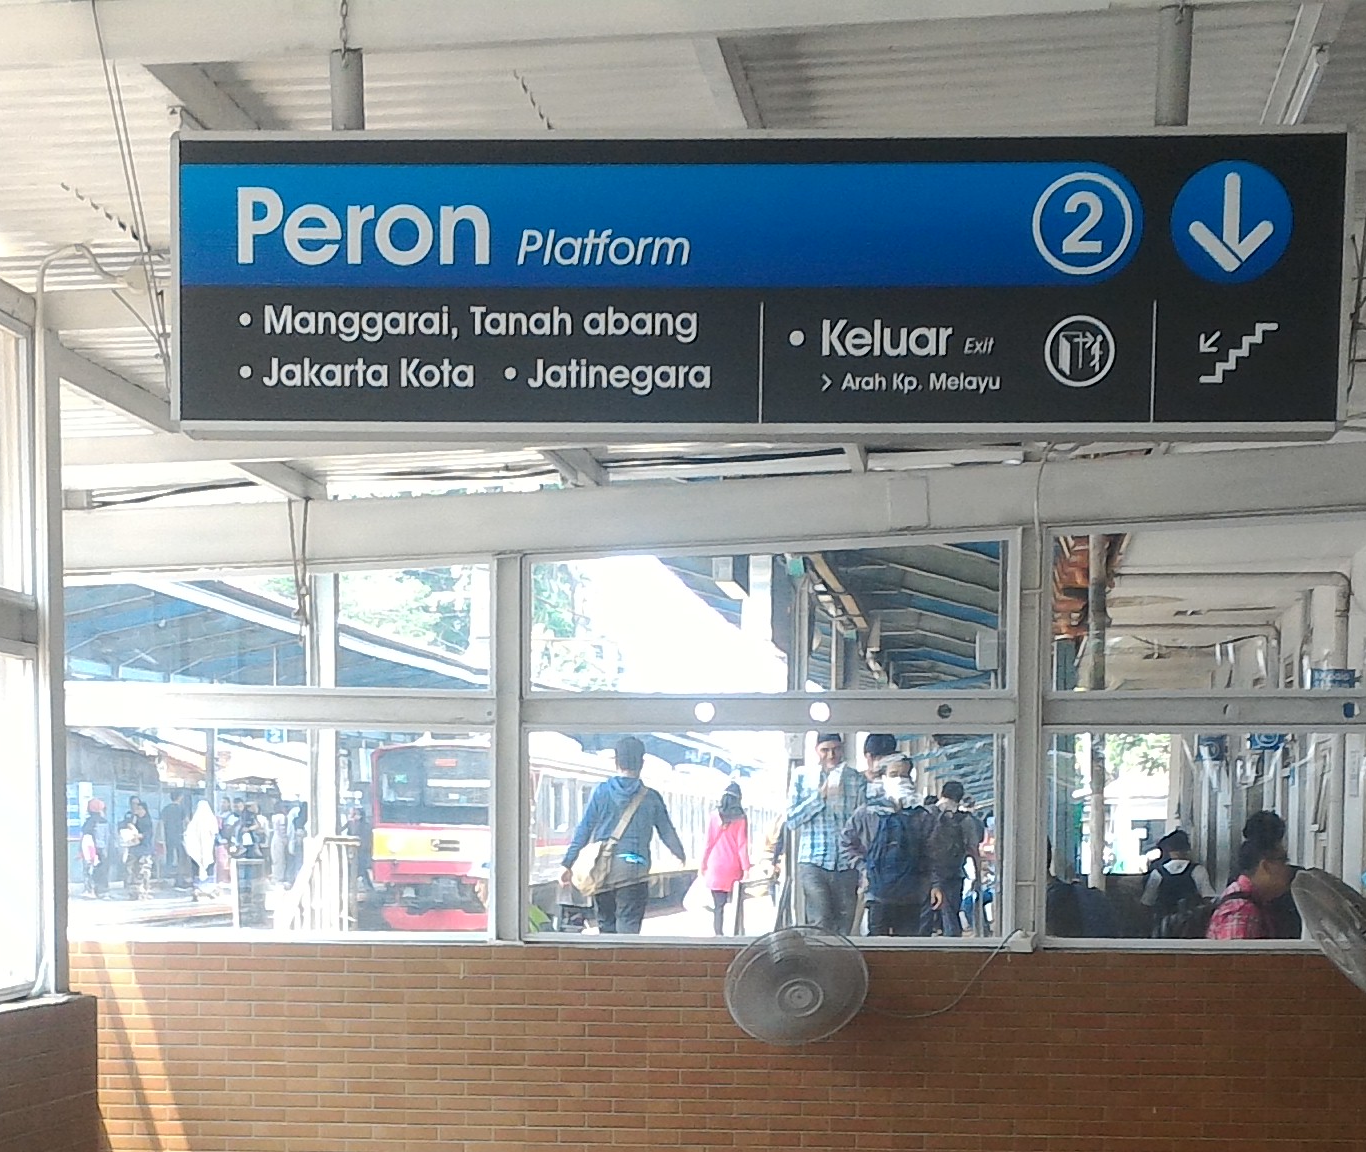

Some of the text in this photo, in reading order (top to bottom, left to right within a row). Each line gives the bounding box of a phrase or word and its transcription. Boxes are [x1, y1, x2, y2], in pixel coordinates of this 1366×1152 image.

[237, 186, 691, 267] Peron Platform
[1062, 190, 1103, 254] 2
[264, 304, 699, 343] Manggarai, Tanah abang
[821, 318, 995, 357] Keluar Exit
[262, 356, 475, 388] Jakarta Kota
[527, 358, 712, 396] Jatinegara
[841, 372, 1002, 394] Arah Kp. Melayu
